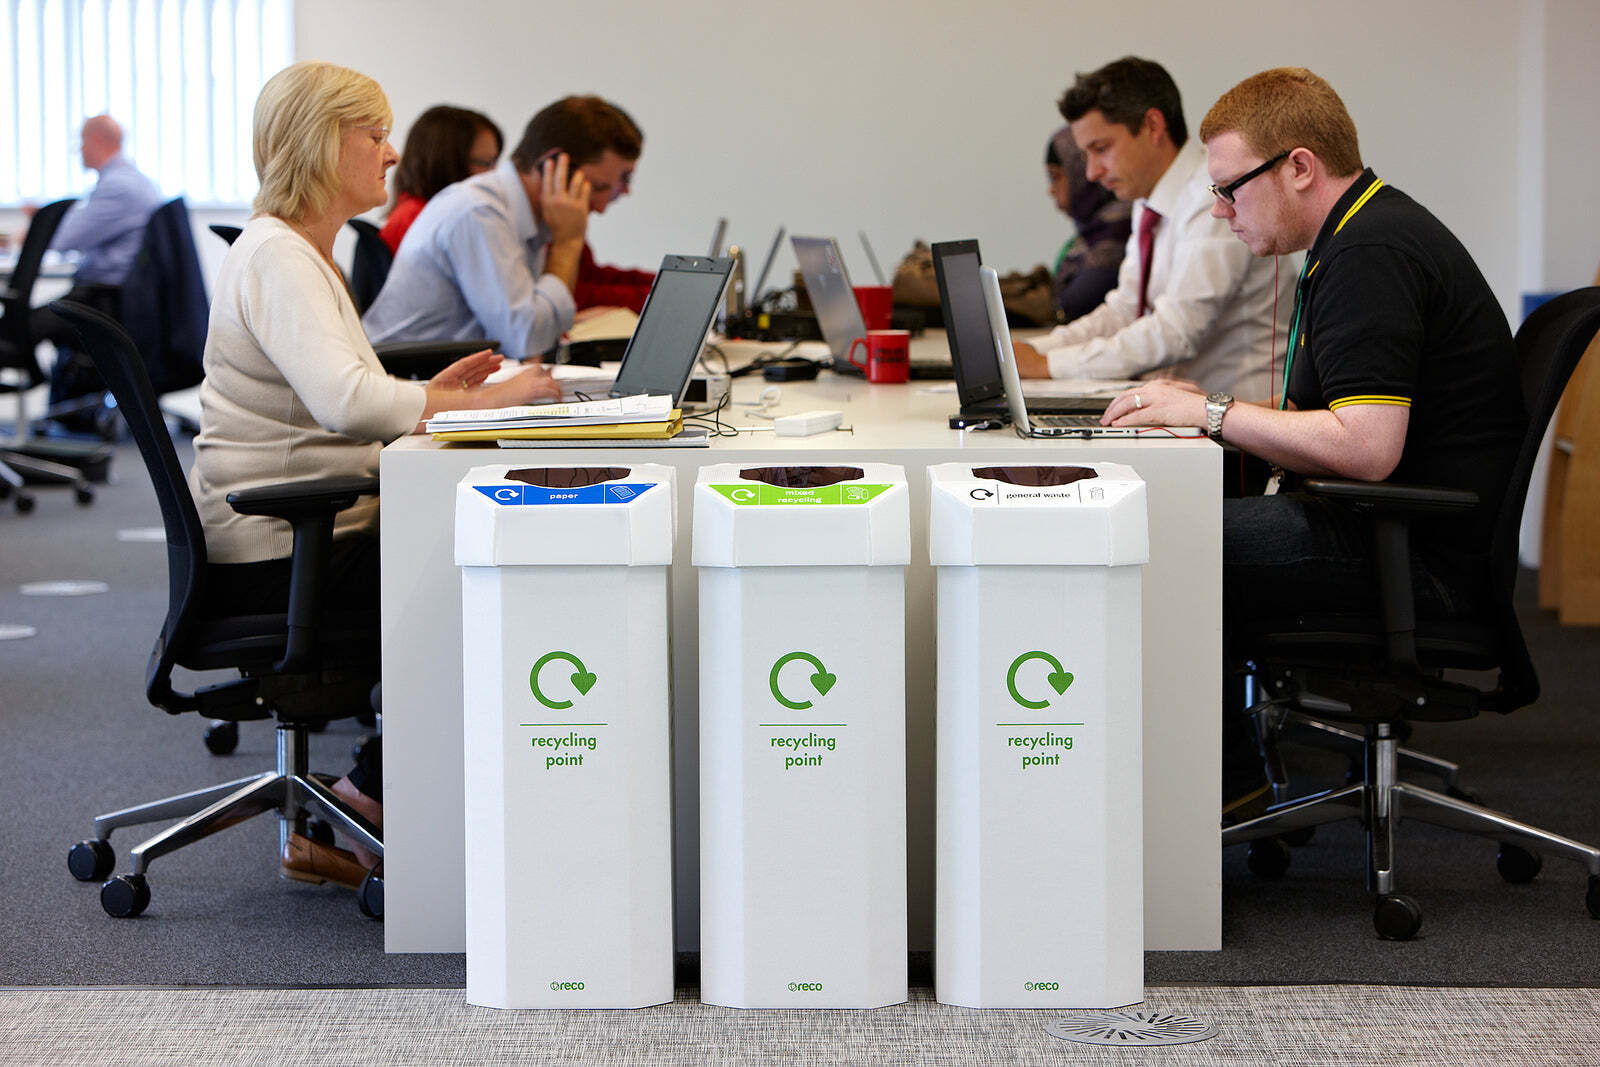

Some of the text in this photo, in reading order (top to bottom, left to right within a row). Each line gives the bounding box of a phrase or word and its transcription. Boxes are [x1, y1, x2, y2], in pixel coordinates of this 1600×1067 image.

[777, 496, 823, 504] recycling
[1006, 492, 1041, 500] general
[531, 731, 597, 751] recycling
[770, 731, 836, 752] recycling
[1007, 732, 1073, 751] recycling
[545, 752, 583, 770] point
[785, 753, 823, 770] point
[1022, 752, 1060, 769] point
[560, 982, 585, 991] reco
[797, 982, 823, 991] reco
[1034, 982, 1059, 991] reco
